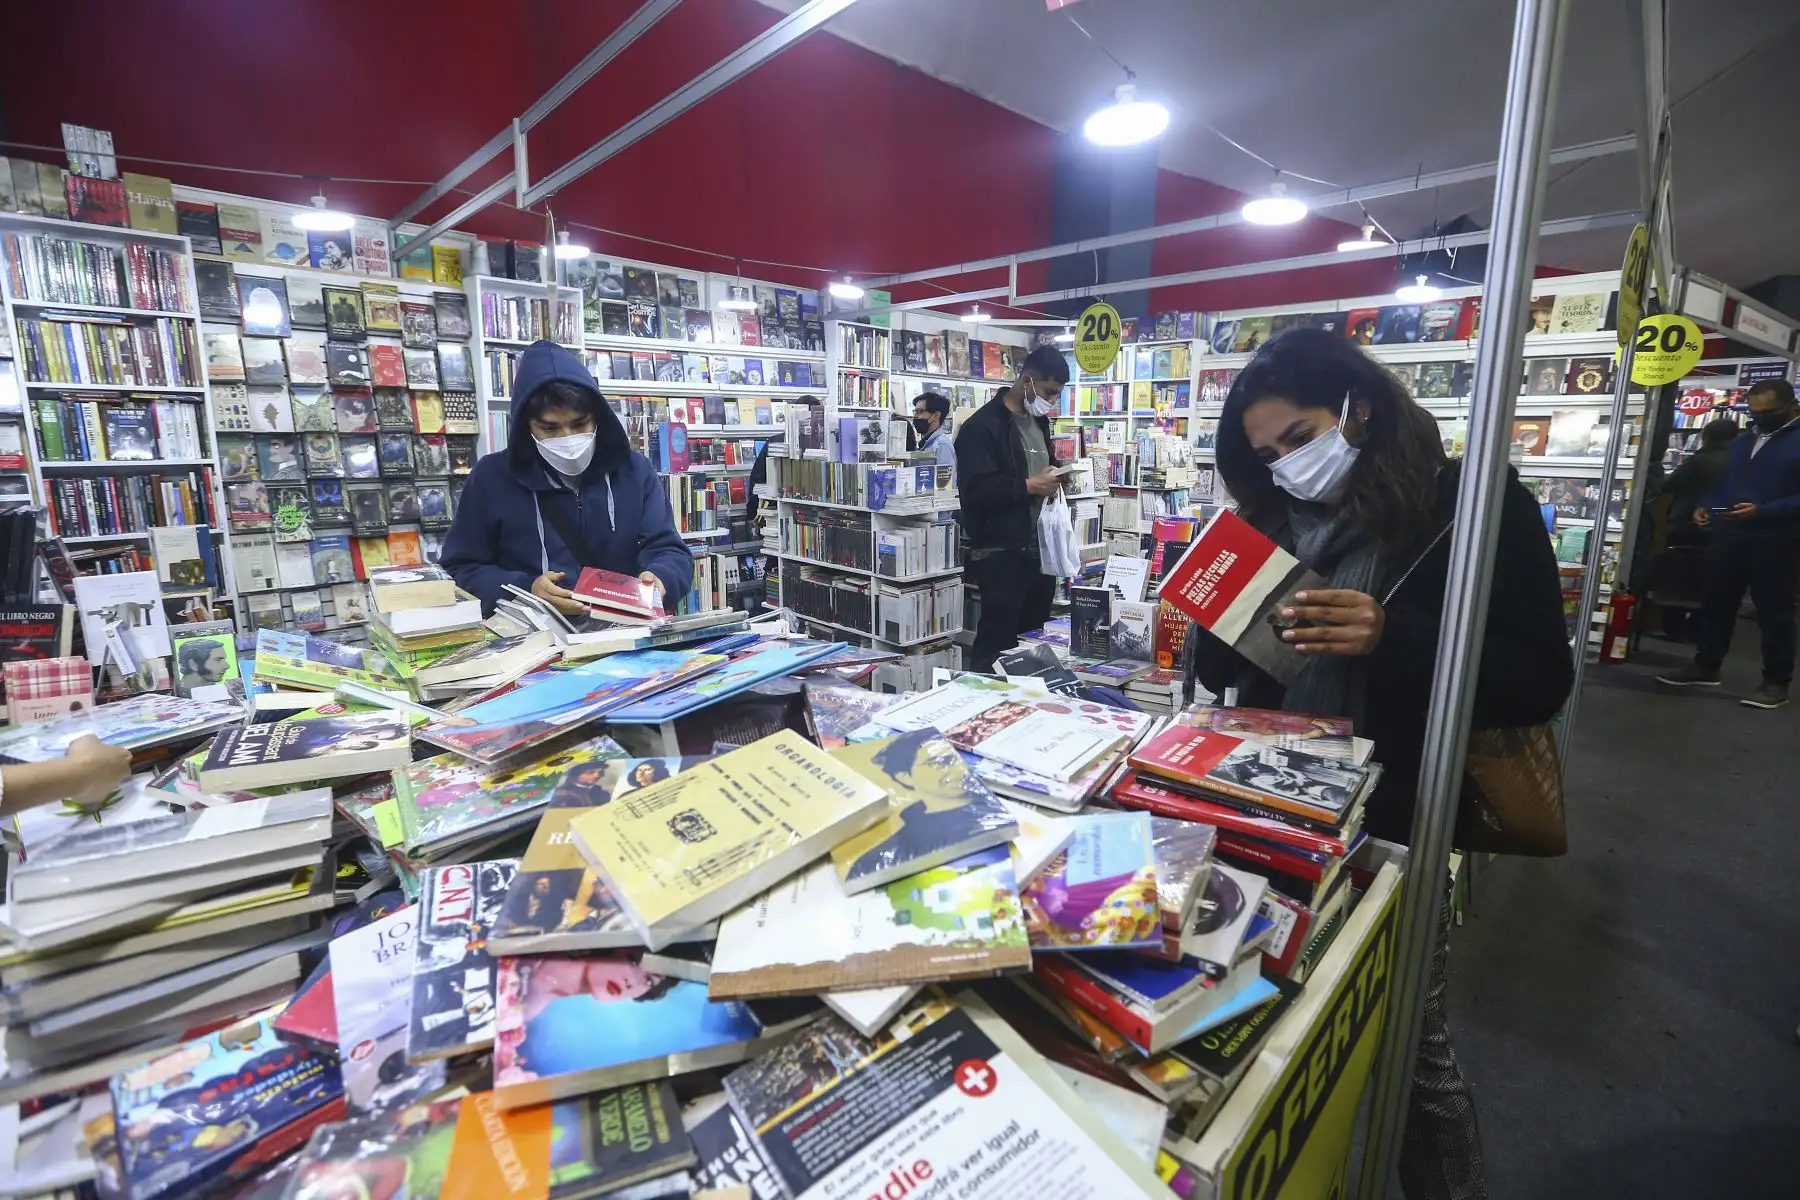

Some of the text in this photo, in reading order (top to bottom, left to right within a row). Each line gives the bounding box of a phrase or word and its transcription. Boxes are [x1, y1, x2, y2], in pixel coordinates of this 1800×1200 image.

[1082, 313, 1119, 342] 20%
[1635, 324, 1698, 353] 20%
[1680, 396, 1711, 409] 20%
[1186, 549, 1231, 601] PIEZAS SECRETAS
[1192, 552, 1239, 606] CONTRA EL MUNDO
[6, 612, 29, 620] LIBRO
[28, 612, 55, 620] NEGRO
[228, 723, 272, 766] BEL AMI
[775, 743, 857, 800] ORGANOLOGIA
[1240, 926, 1388, 1200] OFERTA
[839, 1160, 867, 1184] autor
[918, 1109, 939, 1130] que
[958, 1127, 1042, 1200] consumidor
[961, 1149, 985, 1172] ver
[986, 1119, 1021, 1152] igual
